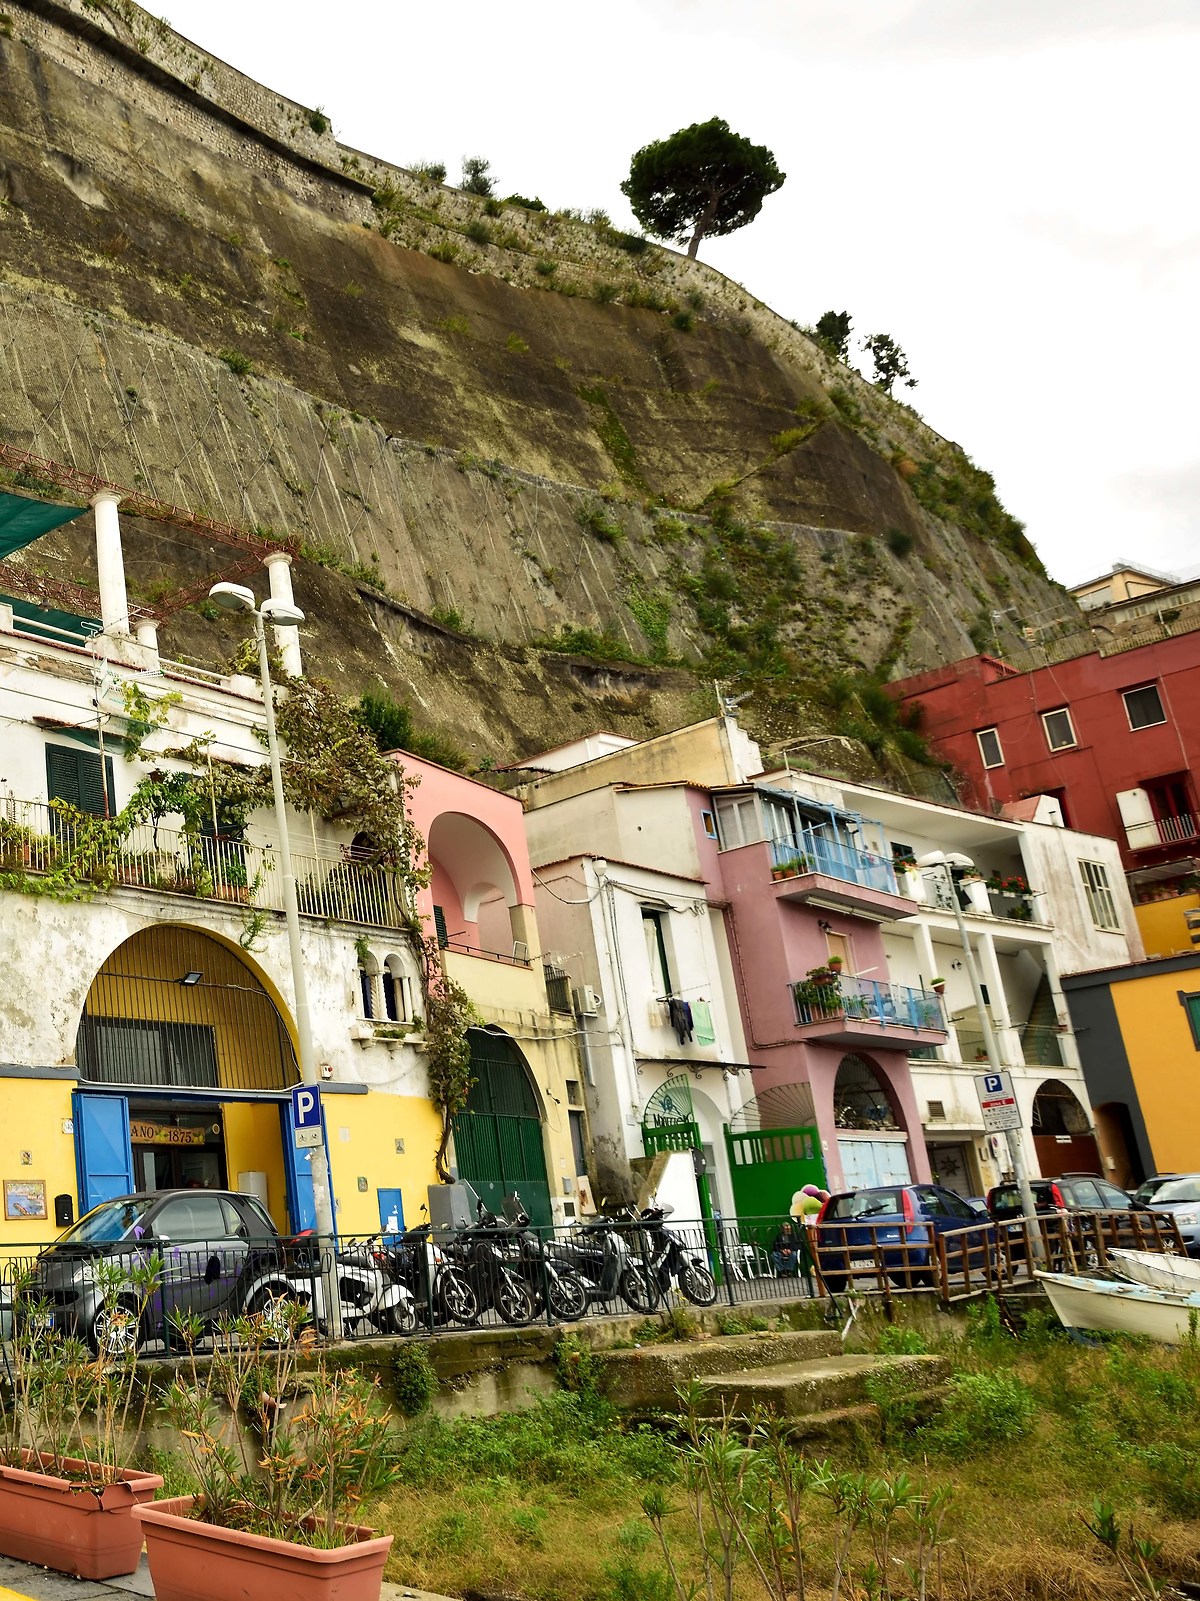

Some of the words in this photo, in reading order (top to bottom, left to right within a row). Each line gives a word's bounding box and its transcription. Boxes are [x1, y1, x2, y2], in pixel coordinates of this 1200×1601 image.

[987, 1077, 998, 1091] P
[297, 1091, 315, 1124] P
[131, 1126, 154, 1139] ANO
